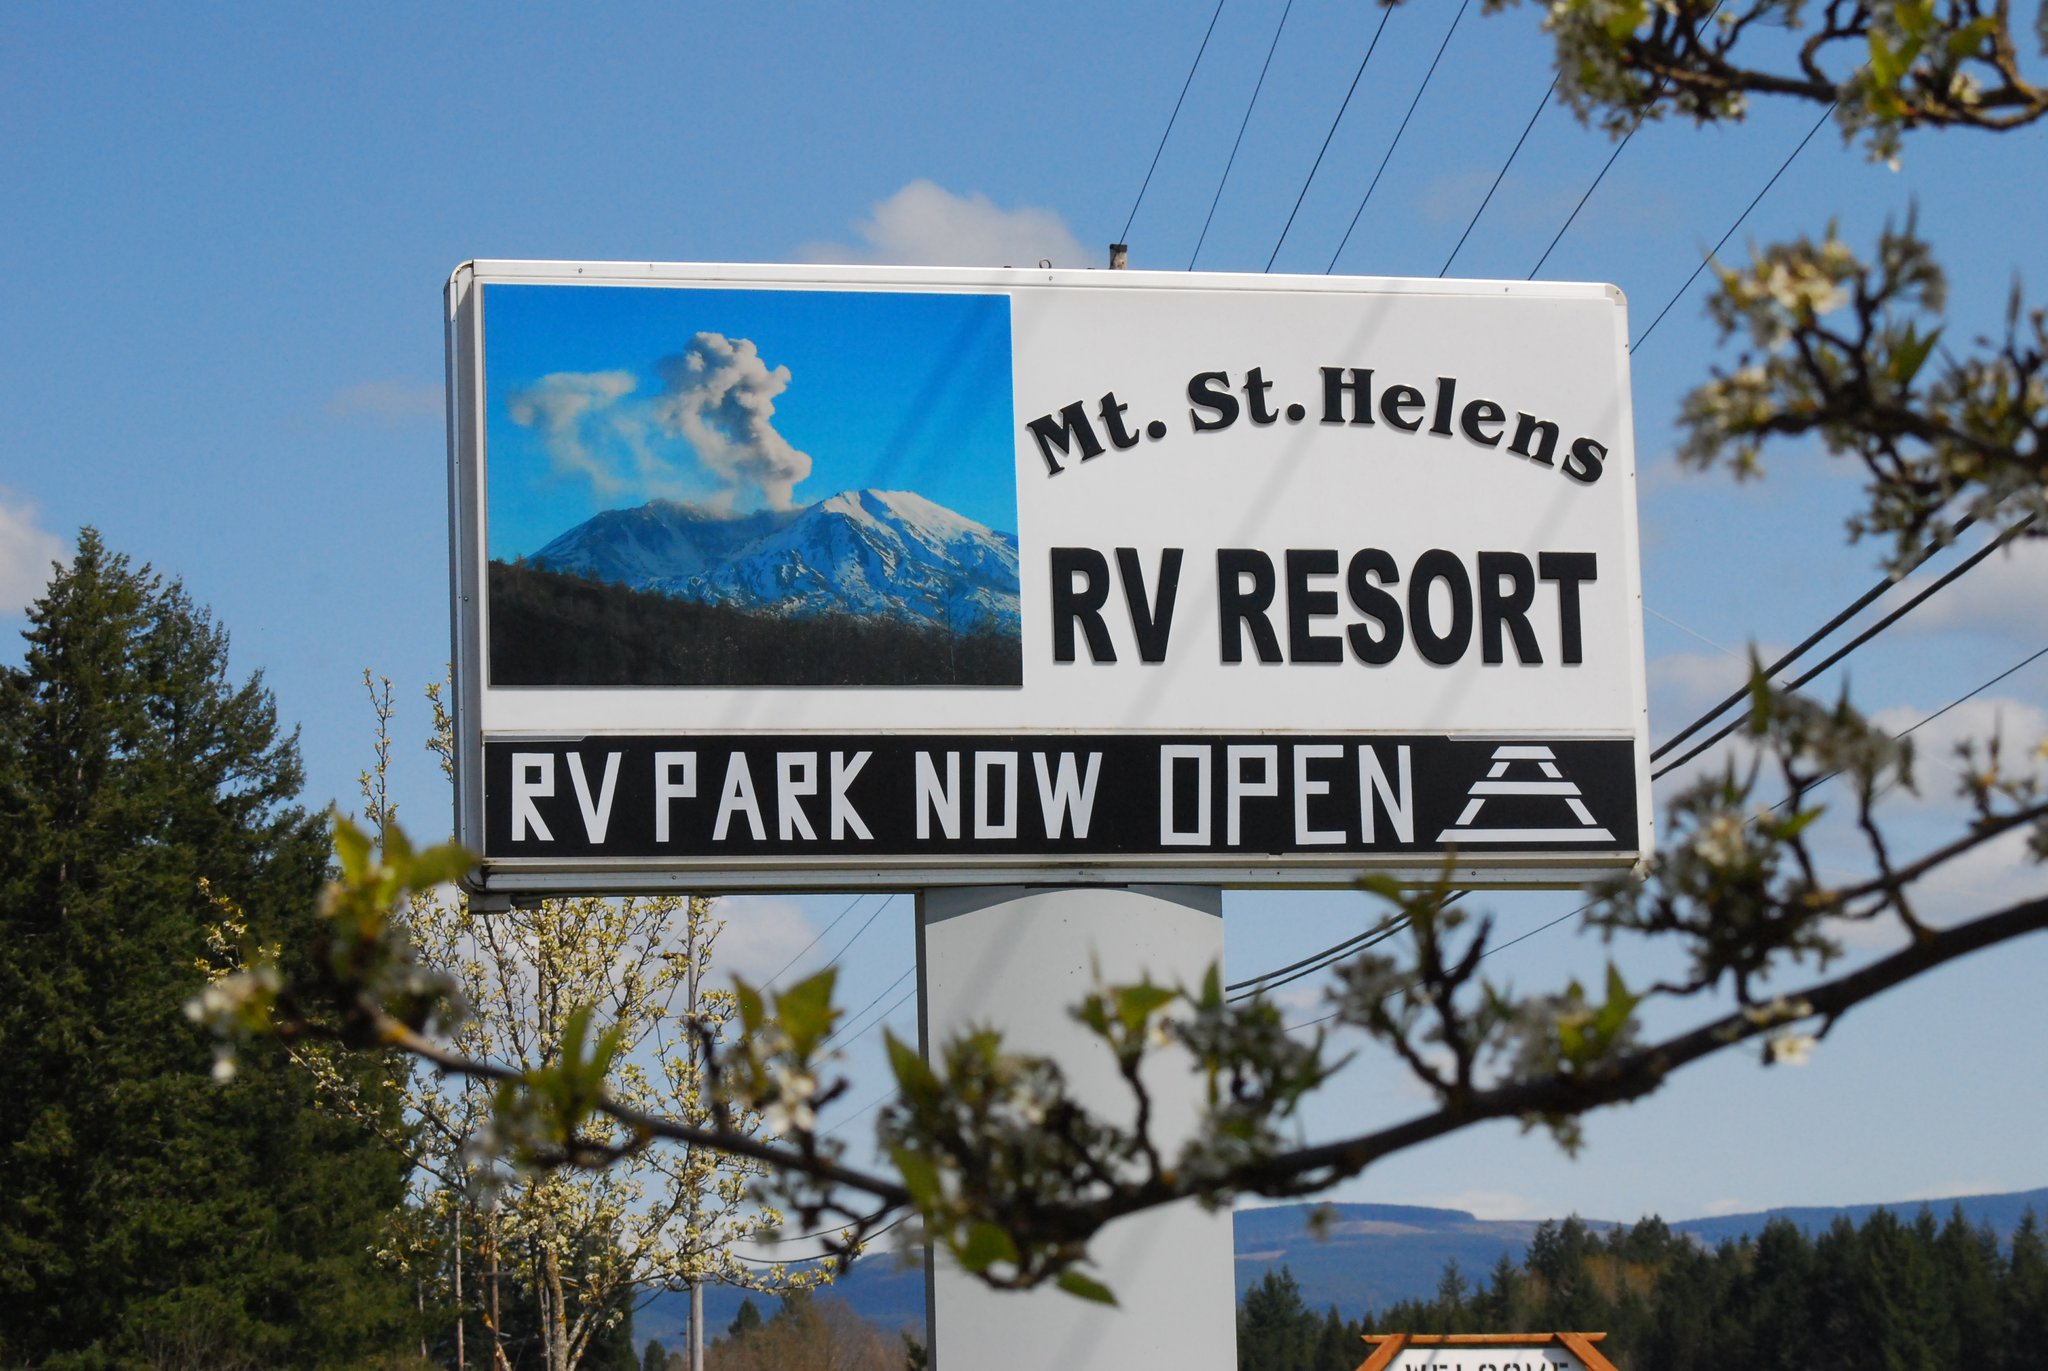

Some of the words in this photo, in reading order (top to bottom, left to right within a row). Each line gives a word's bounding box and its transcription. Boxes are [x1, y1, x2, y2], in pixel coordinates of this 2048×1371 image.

[1026, 390, 1168, 476] Mt.
[1187, 366, 1307, 433] St.
[1319, 366, 1609, 484] Helens
[1050, 546, 1185, 663] RV
[1216, 547, 1598, 666] RESORT
[511, 752, 622, 844] RV
[655, 751, 875, 842] PARK
[915, 751, 1103, 840] NOW
[1160, 744, 1415, 846] OPEN
